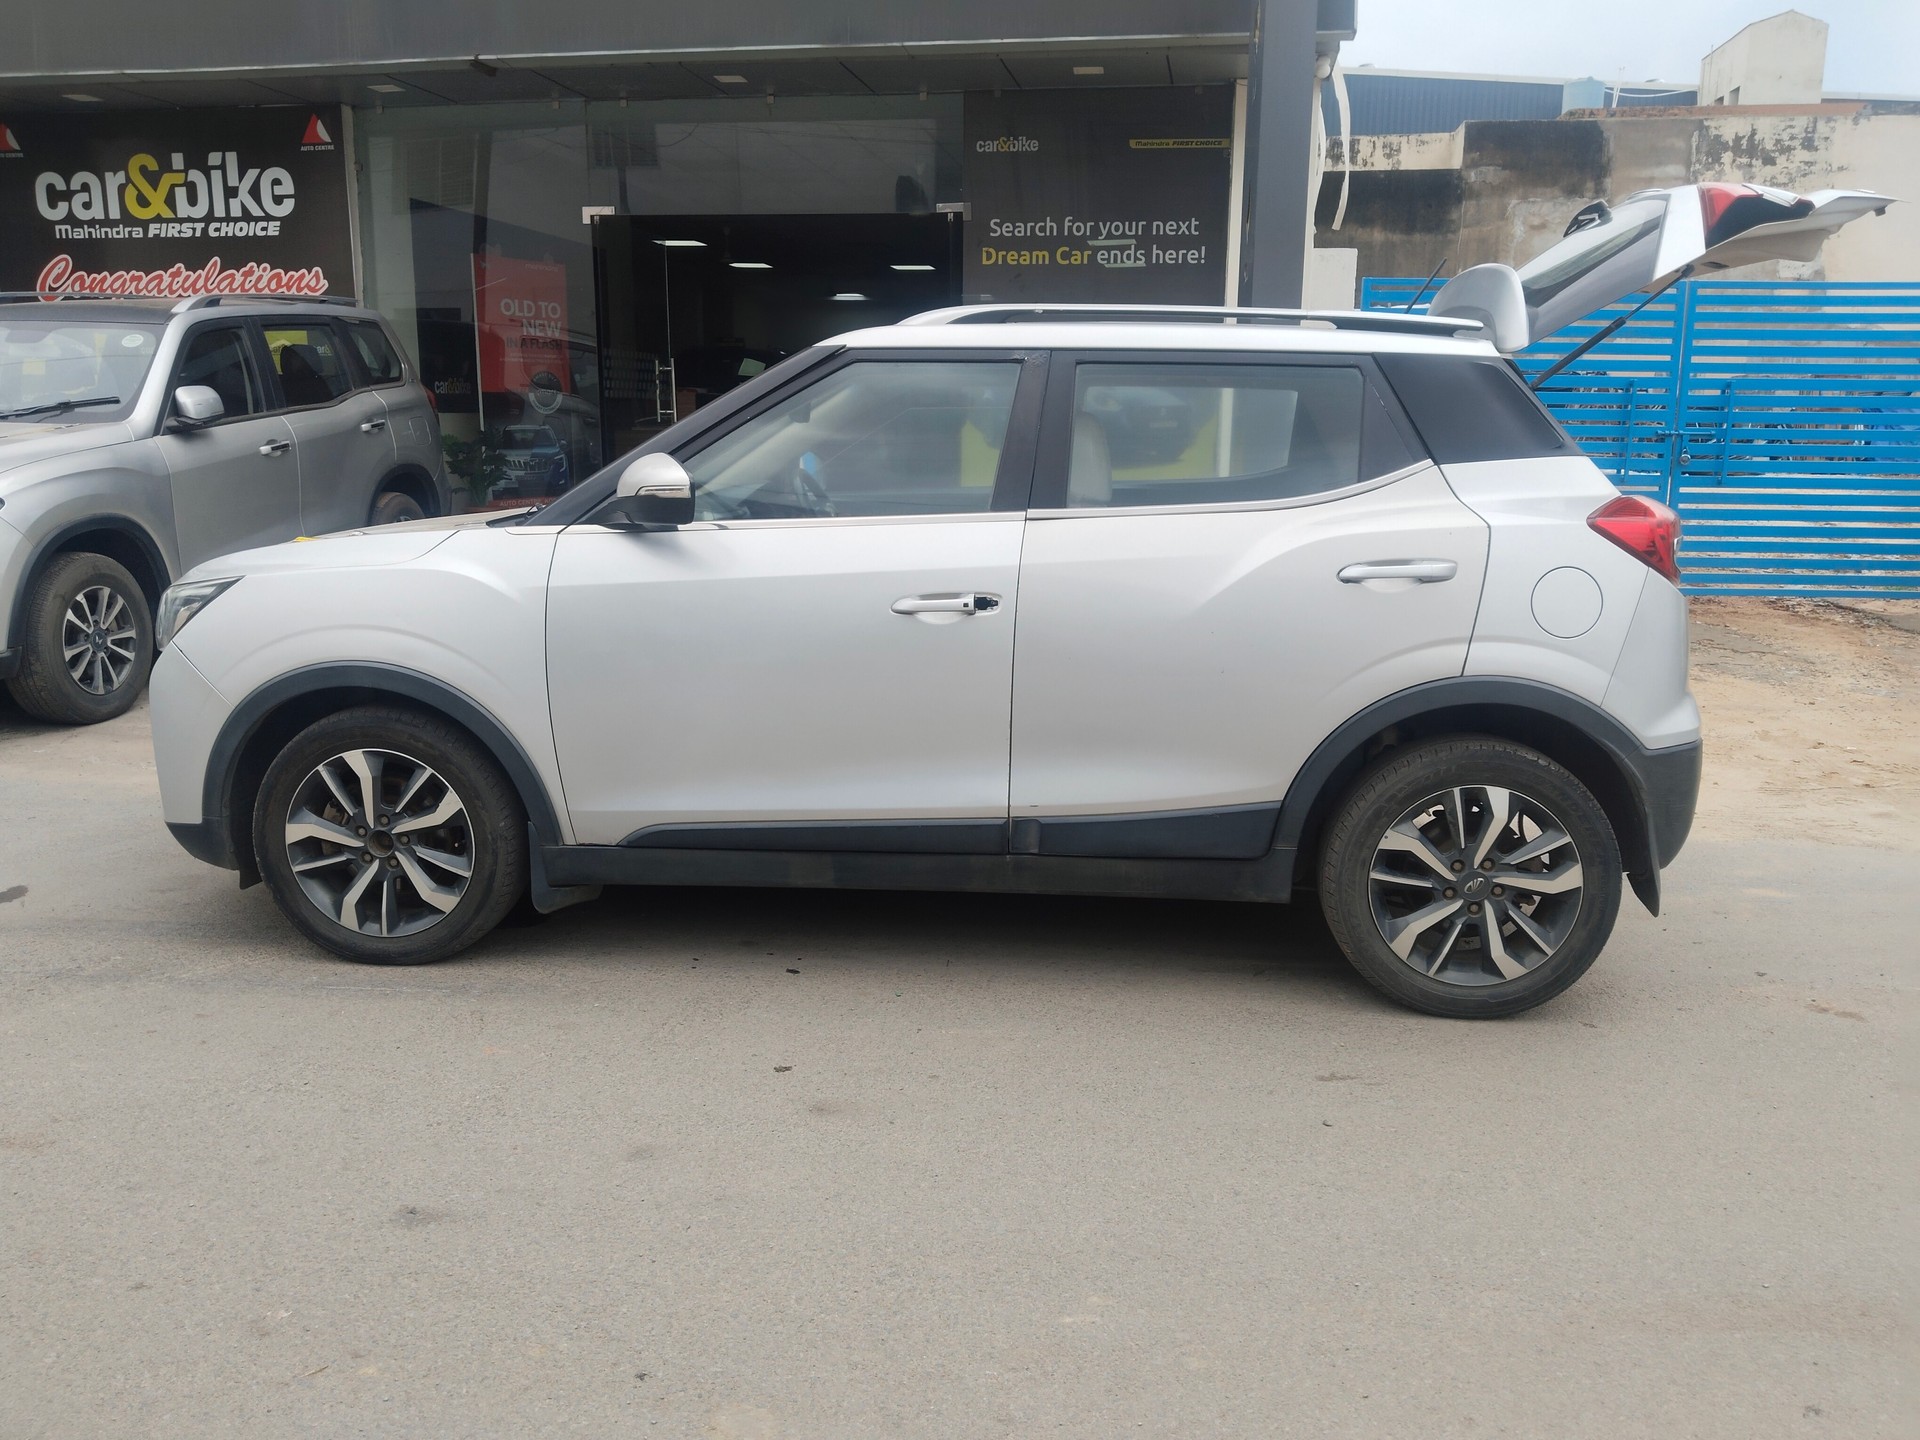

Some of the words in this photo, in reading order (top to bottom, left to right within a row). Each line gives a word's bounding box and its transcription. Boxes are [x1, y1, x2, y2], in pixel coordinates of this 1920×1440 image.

[976, 136, 1039, 152] car&bike
[35, 151, 296, 221] car&bike
[55, 224, 144, 239] Mahindra
[148, 222, 205, 238] FIRST
[208, 220, 281, 237] CHOICE
[989, 216, 1058, 237] Search
[1064, 216, 1095, 236] for
[1099, 219, 1147, 239] your
[1152, 217, 1199, 235] next
[981, 246, 1050, 266] Dream
[1056, 246, 1092, 265] Car
[1096, 245, 1146, 265] ends
[1152, 244, 1206, 264] here!
[36, 253, 330, 303] Congratulations
[501, 297, 536, 318] OLD
[537, 301, 561, 319] TO
[522, 318, 563, 338] NEW
[506, 337, 518, 349] IN
[520, 337, 529, 349] A
